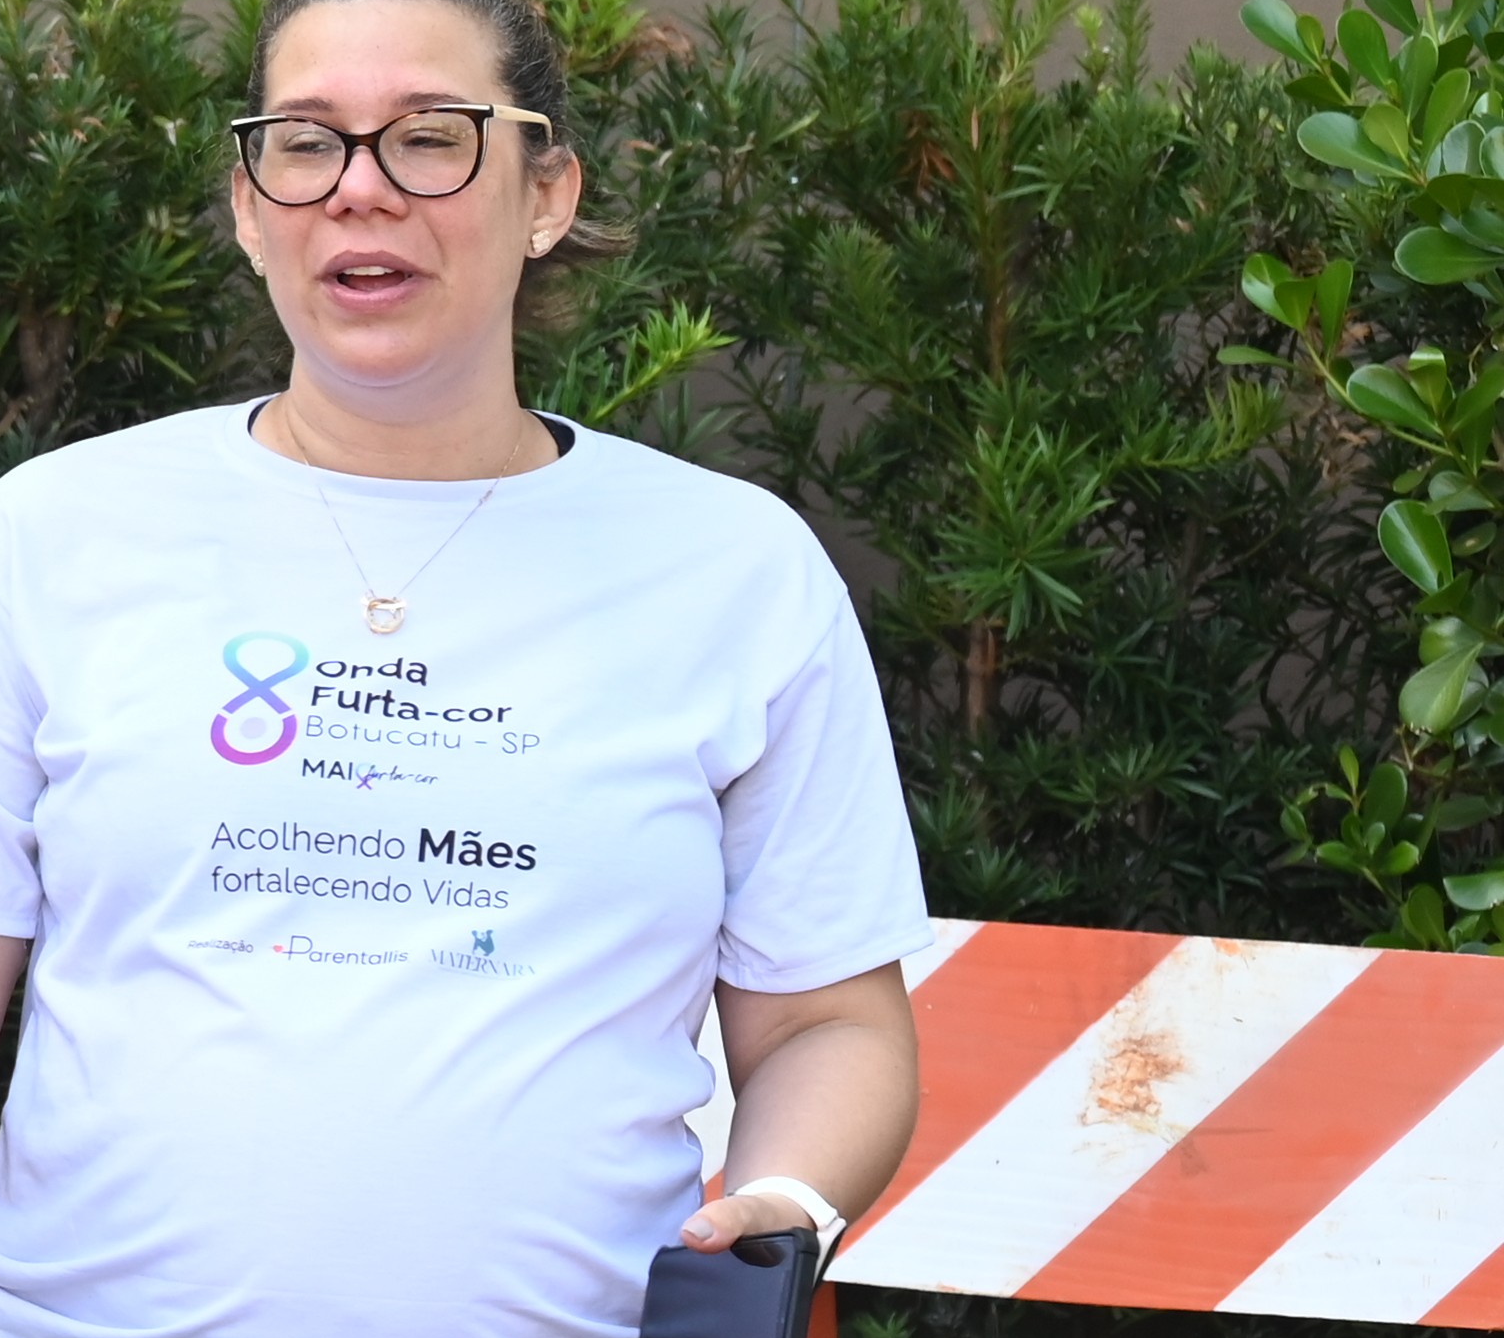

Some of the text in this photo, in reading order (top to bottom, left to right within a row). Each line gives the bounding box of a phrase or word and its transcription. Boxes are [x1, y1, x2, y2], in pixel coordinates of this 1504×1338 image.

[316, 657, 429, 687] Onda
[311, 685, 513, 723] Furta-cor
[305, 715, 462, 749] Botucatu
[502, 732, 540, 755] SP
[211, 822, 537, 871] Acolhendo Mães
[211, 866, 509, 909] fortalecendo Vidas
[282, 935, 408, 965] Parentallis
